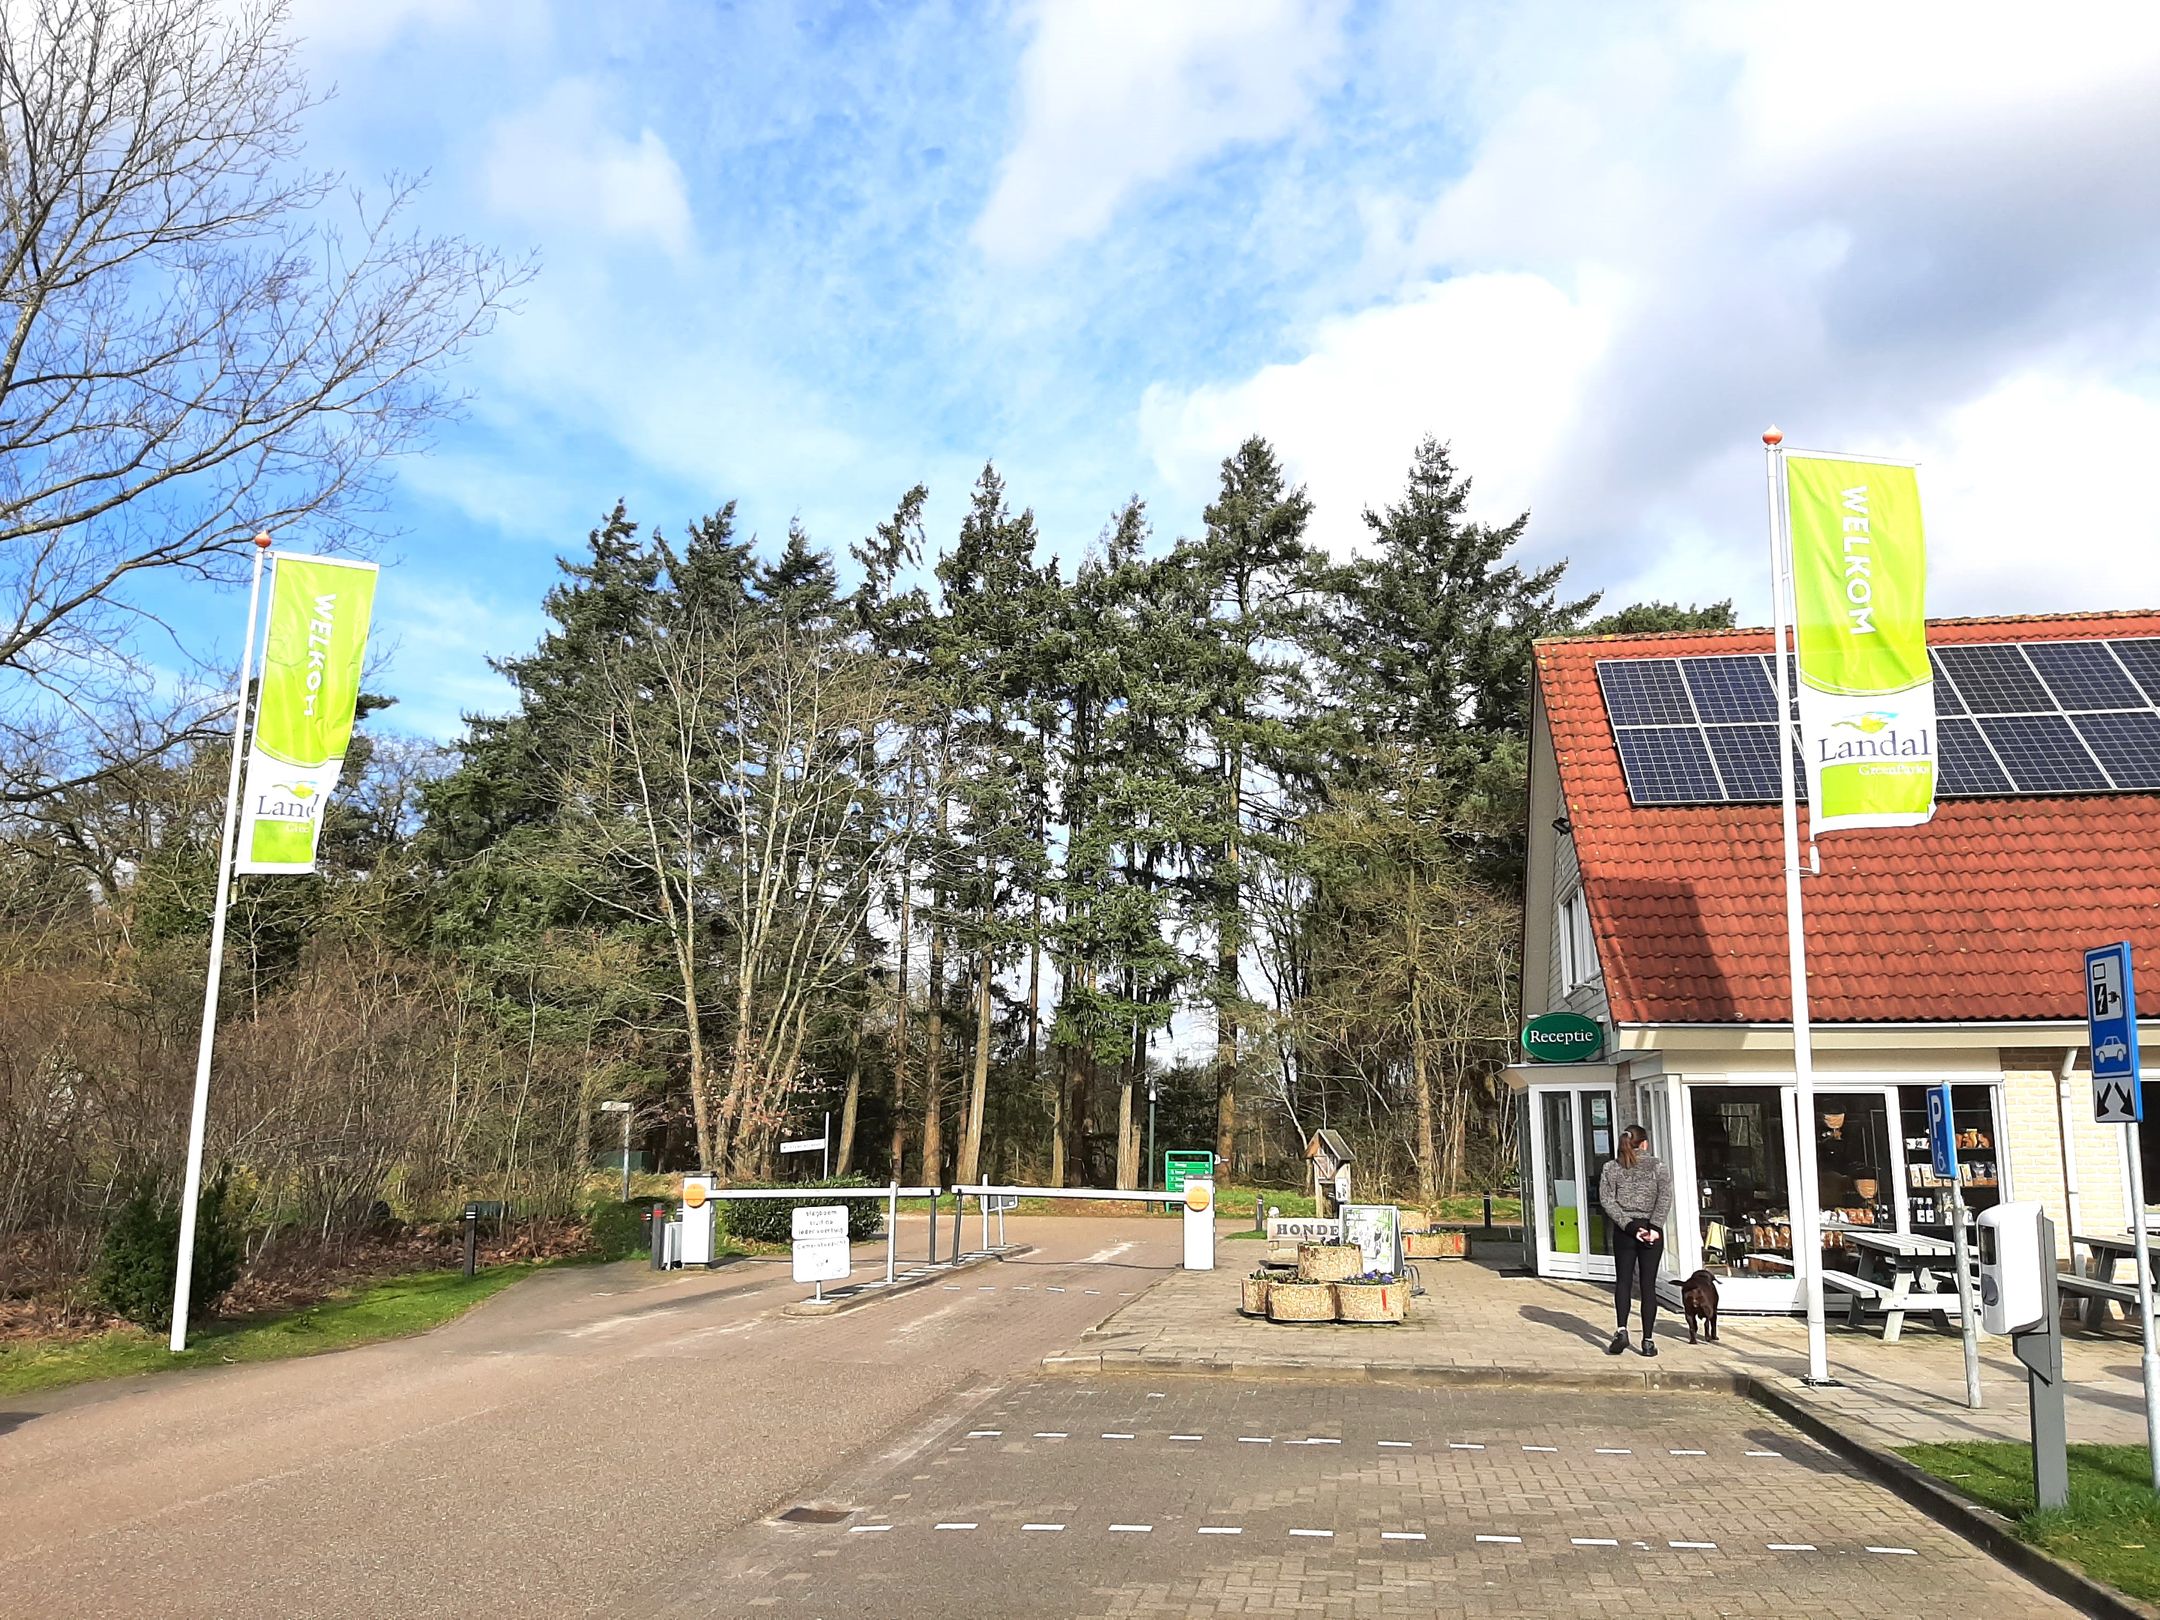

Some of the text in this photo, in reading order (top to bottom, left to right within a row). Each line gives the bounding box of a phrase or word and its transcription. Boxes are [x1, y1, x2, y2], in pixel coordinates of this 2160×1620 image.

[1840, 485, 1877, 634] WELKOM
[1817, 729, 1932, 763] Landal
[1530, 1029, 1594, 1046] Receptie
[1930, 1094, 1942, 1139] P
